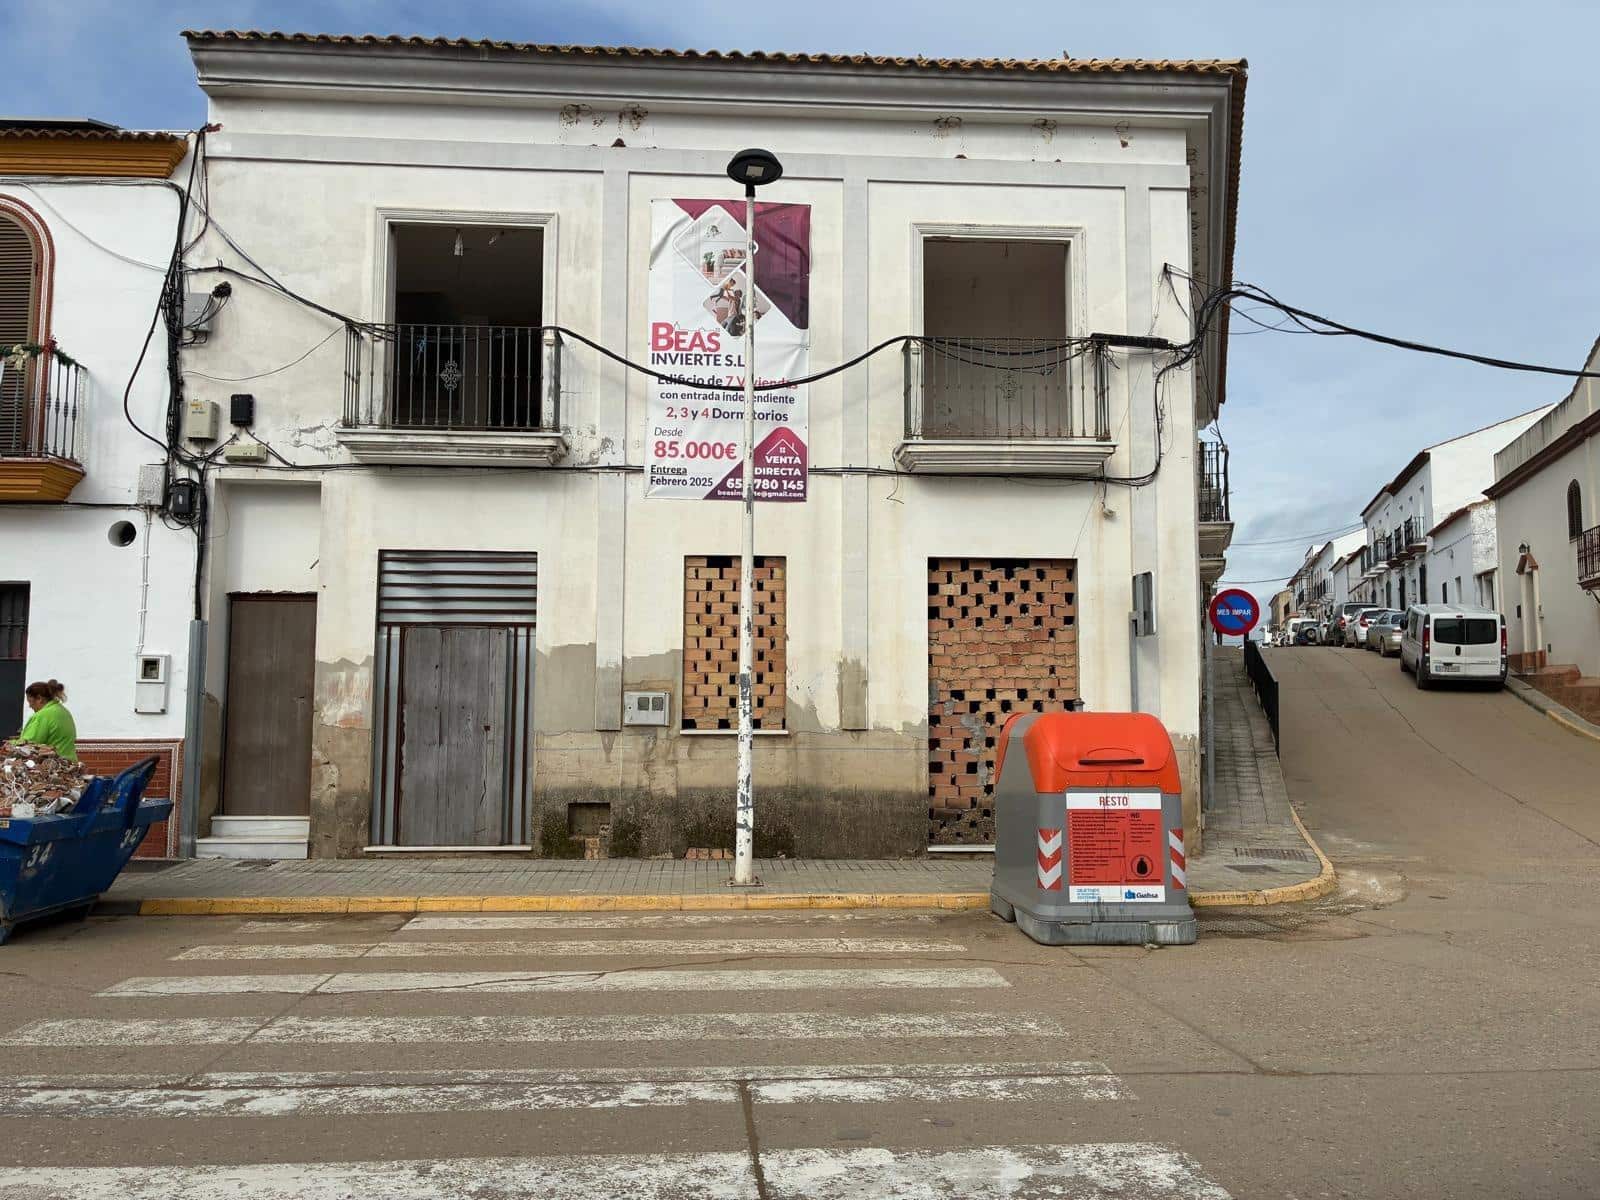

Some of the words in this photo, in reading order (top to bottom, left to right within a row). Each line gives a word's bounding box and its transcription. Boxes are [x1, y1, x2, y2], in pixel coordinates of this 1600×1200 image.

[651, 322, 721, 353] BEAS
[651, 352, 722, 367] INVIERTE
[707, 374, 723, 387] de
[725, 375, 734, 388] 7
[660, 392, 678, 400] con
[680, 391, 720, 401] entrada
[666, 406, 677, 419] 2,
[680, 407, 689, 418] 3
[691, 409, 699, 421] y
[701, 407, 710, 419] 4
[712, 407, 789, 422] Dormtorios
[654, 427, 683, 437] Desde
[654, 440, 737, 460] 85.000€
[765, 456, 802, 465] VENTA
[650, 465, 687, 476] Entrega
[754, 467, 802, 477] DIRECTA
[650, 476, 688, 487] Febrero
[690, 477, 713, 488] 2025
[754, 478, 778, 490] 780
[782, 480, 804, 491] 145
[1099, 796, 1129, 806] RESTO
